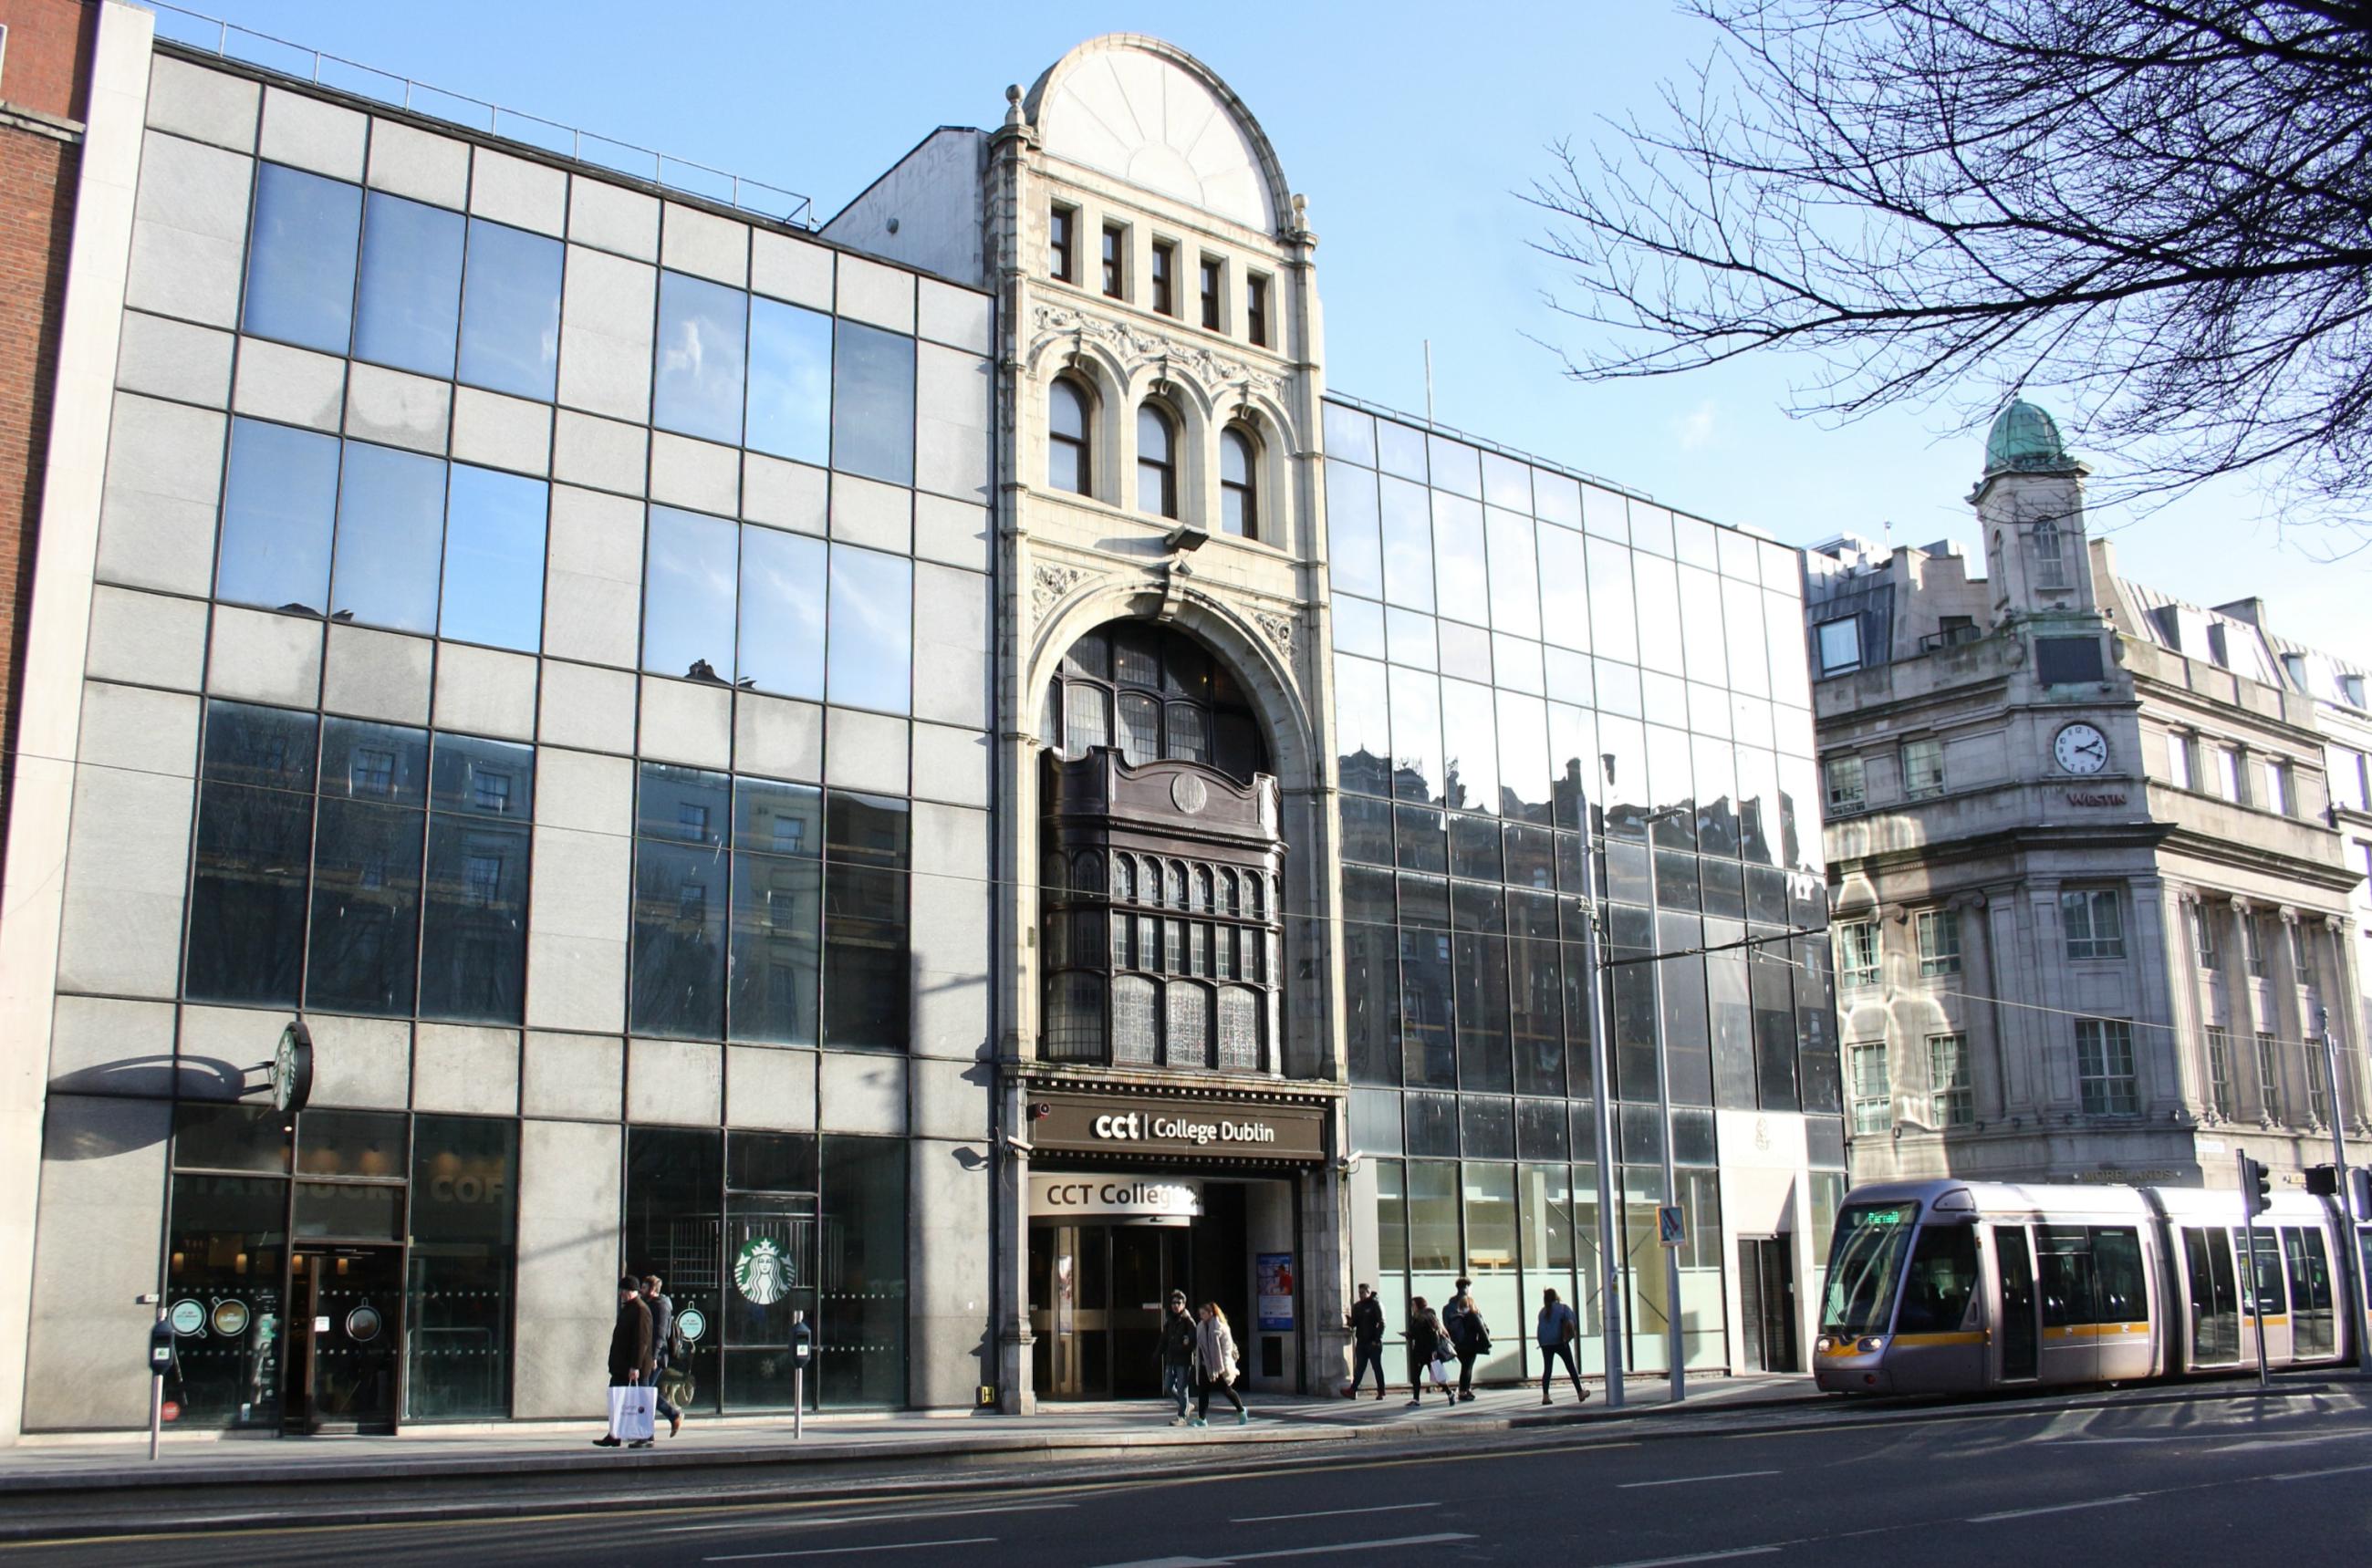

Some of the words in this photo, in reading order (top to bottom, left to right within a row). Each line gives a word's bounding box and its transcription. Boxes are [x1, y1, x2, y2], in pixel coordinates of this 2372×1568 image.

[1096, 1112, 1139, 1139] cct
[1154, 1117, 1217, 1144] College
[1222, 1121, 1274, 1141] Dublin
[1046, 1184, 1093, 1205] CCT
[1099, 1183, 1182, 1210] Colleg
[983, 1387, 993, 1402] H
